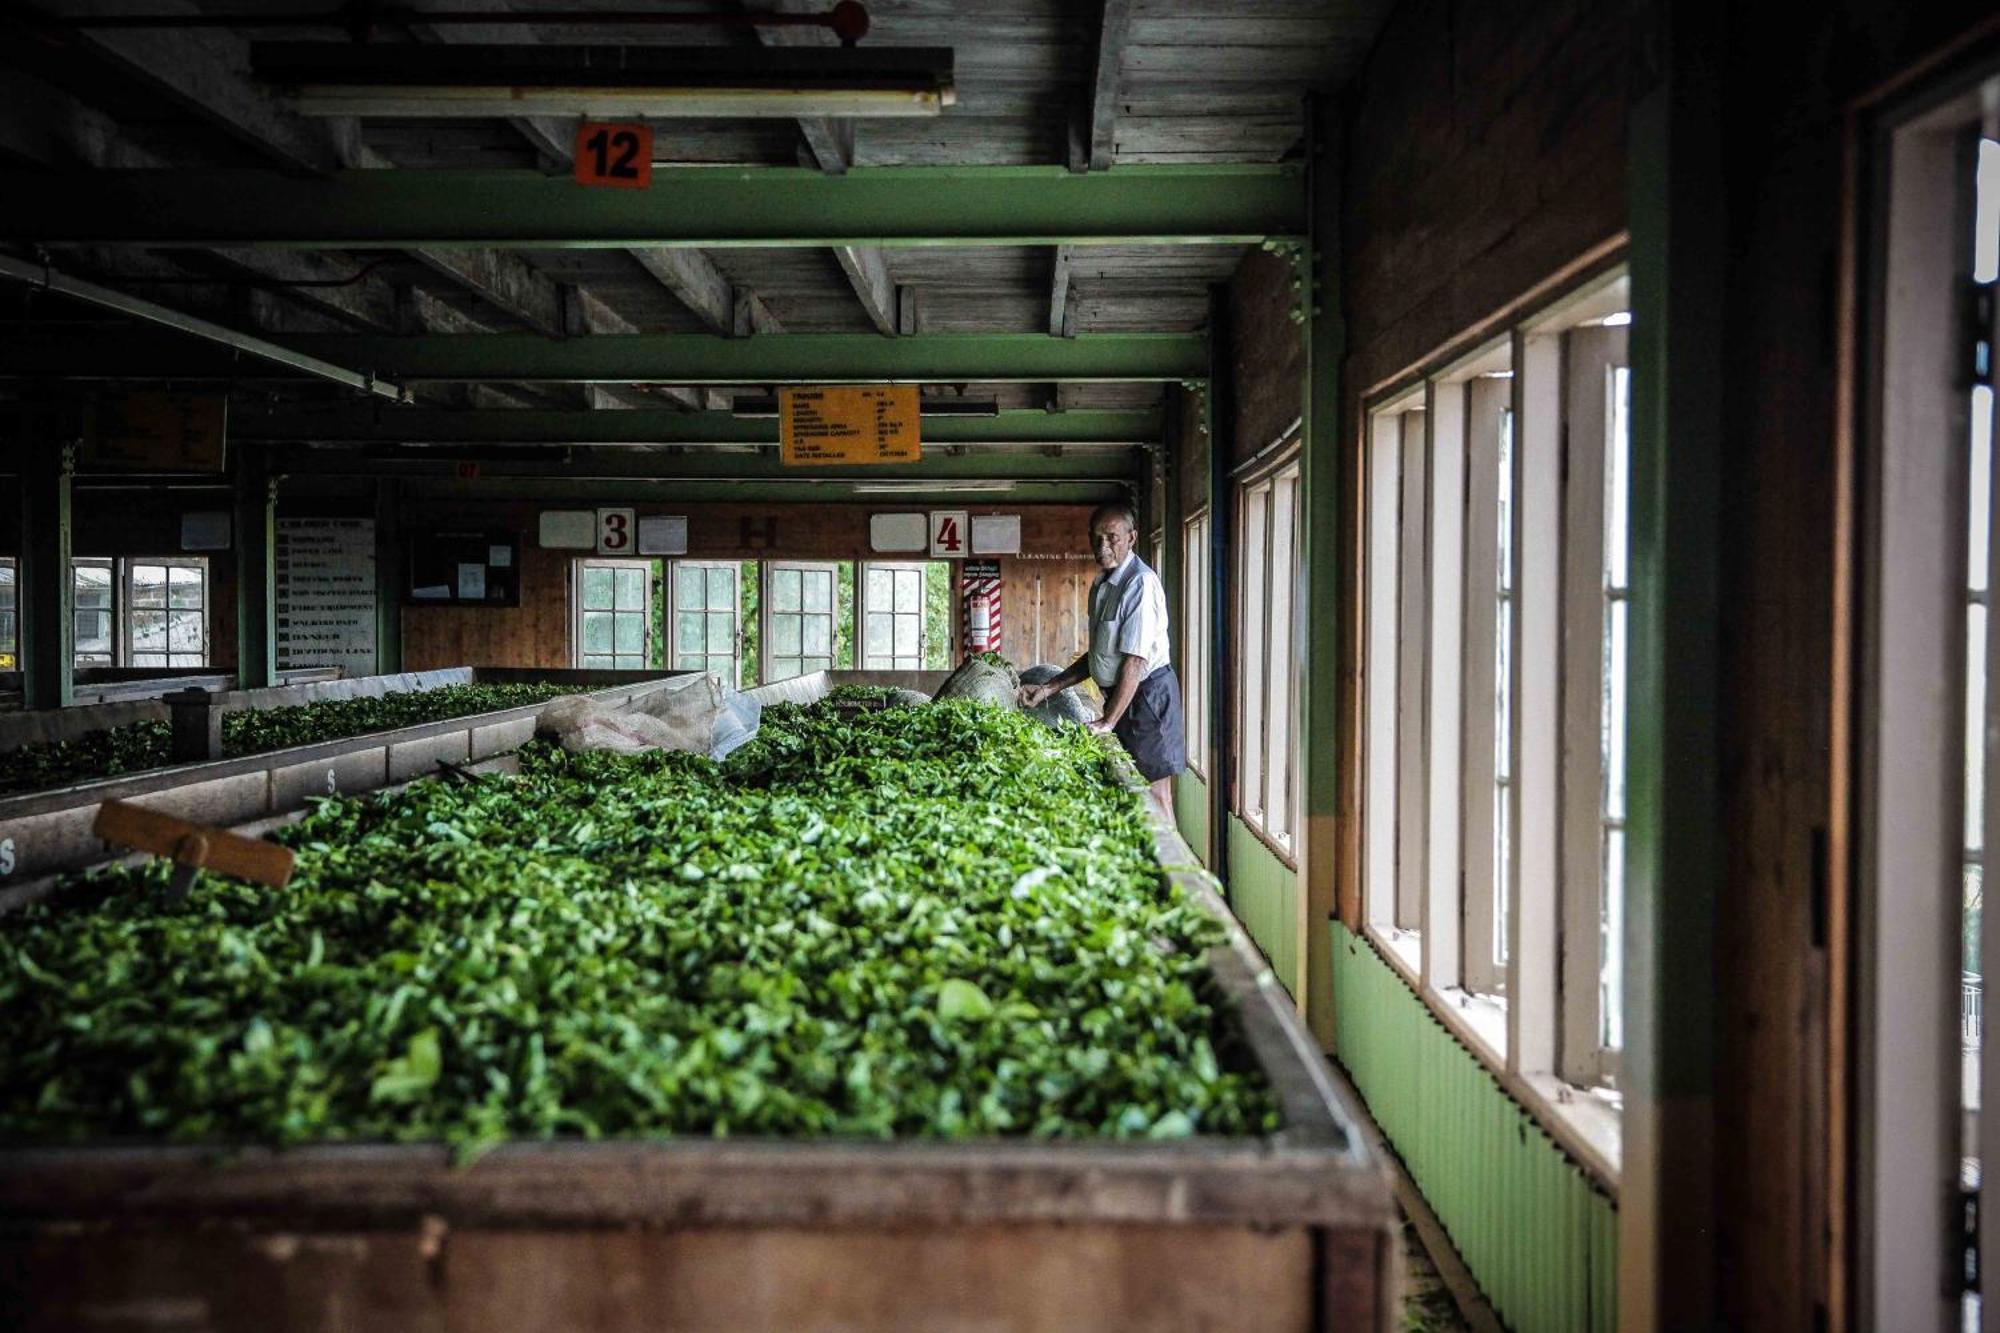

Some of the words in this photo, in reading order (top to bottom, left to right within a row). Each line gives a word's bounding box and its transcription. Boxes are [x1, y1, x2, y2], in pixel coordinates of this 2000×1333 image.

[586, 129, 639, 178] 12
[604, 514, 627, 548] 3
[937, 517, 962, 551] 4
[1016, 552, 1062, 560] CLEANING
